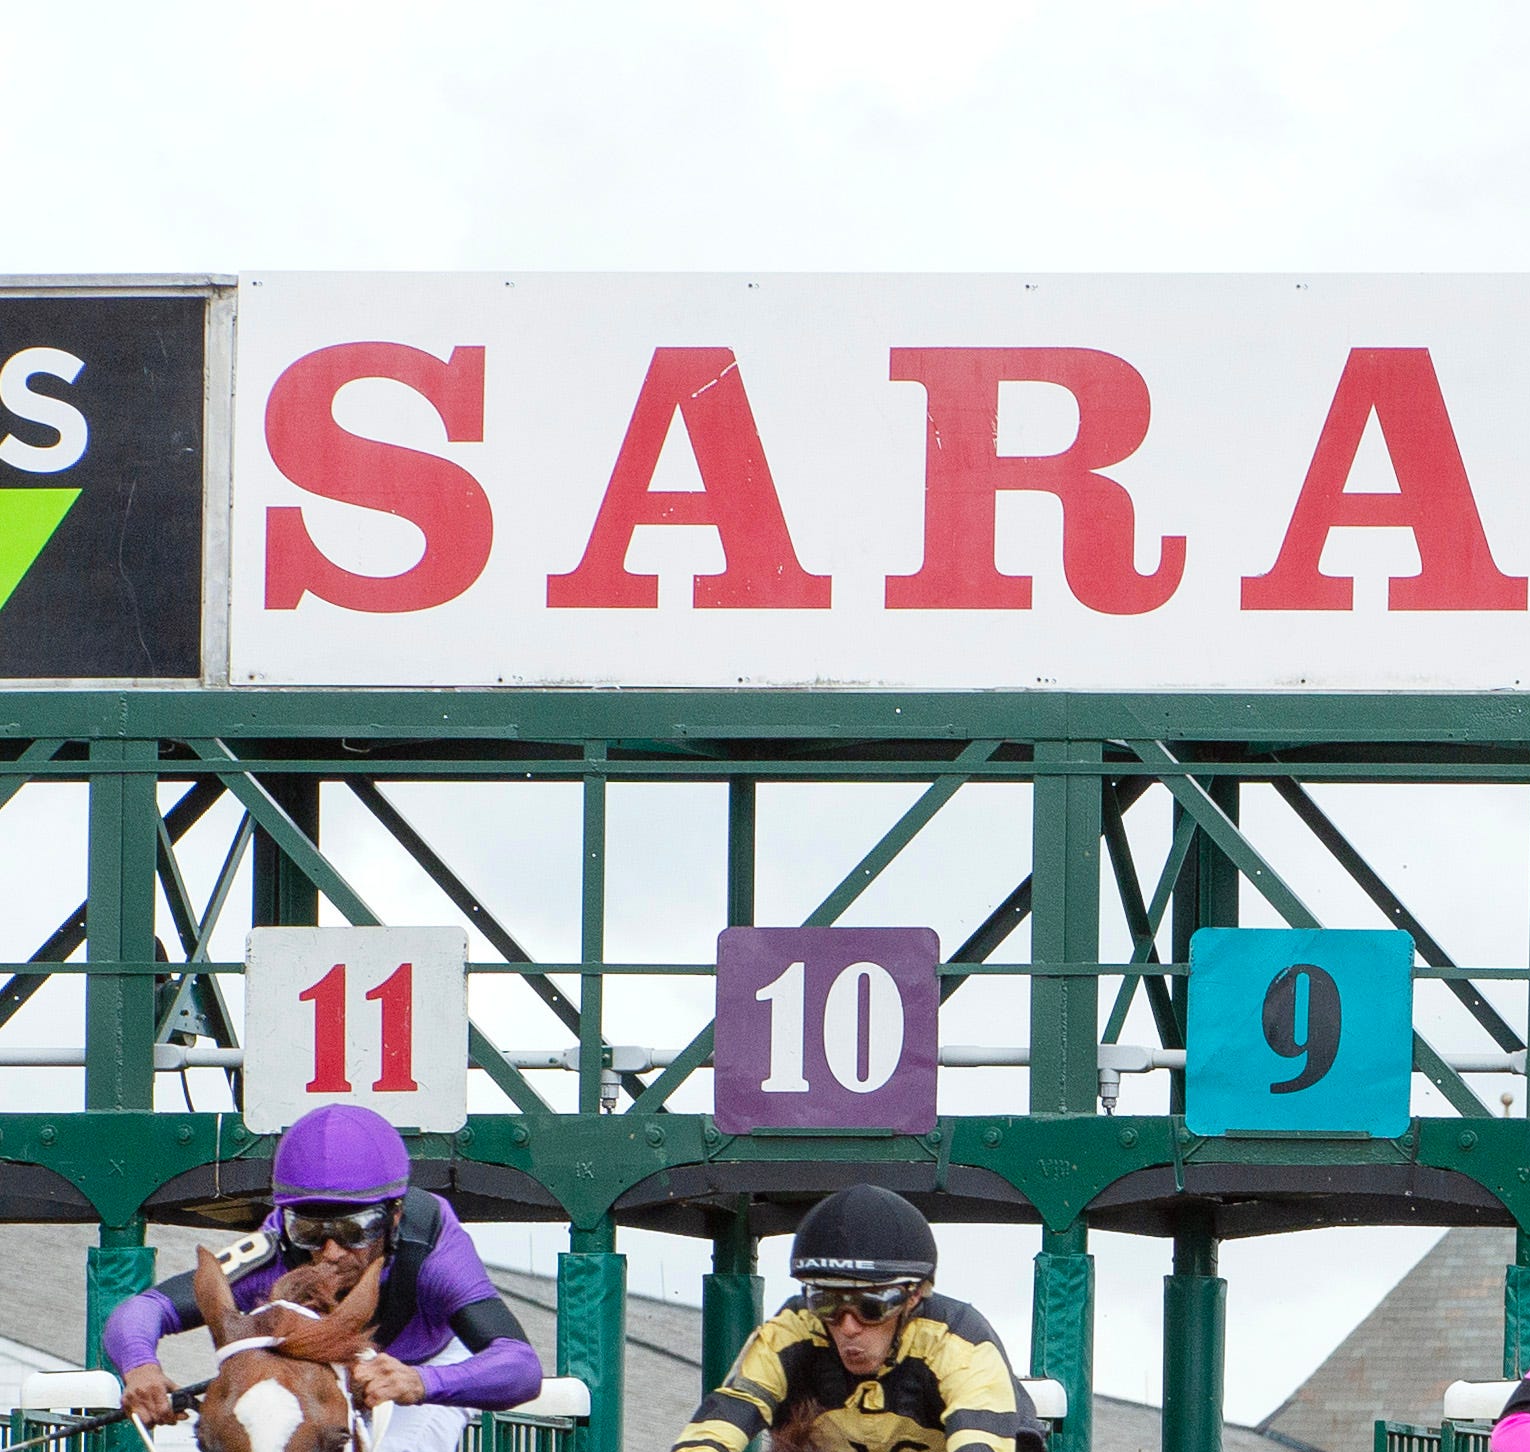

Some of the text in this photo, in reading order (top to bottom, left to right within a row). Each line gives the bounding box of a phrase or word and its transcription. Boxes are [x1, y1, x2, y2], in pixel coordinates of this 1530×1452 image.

[300, 963, 418, 1093] 11
[755, 961, 905, 1094] 10
[1262, 964, 1342, 1094] 9
[796, 1258, 875, 1270] JAIME
